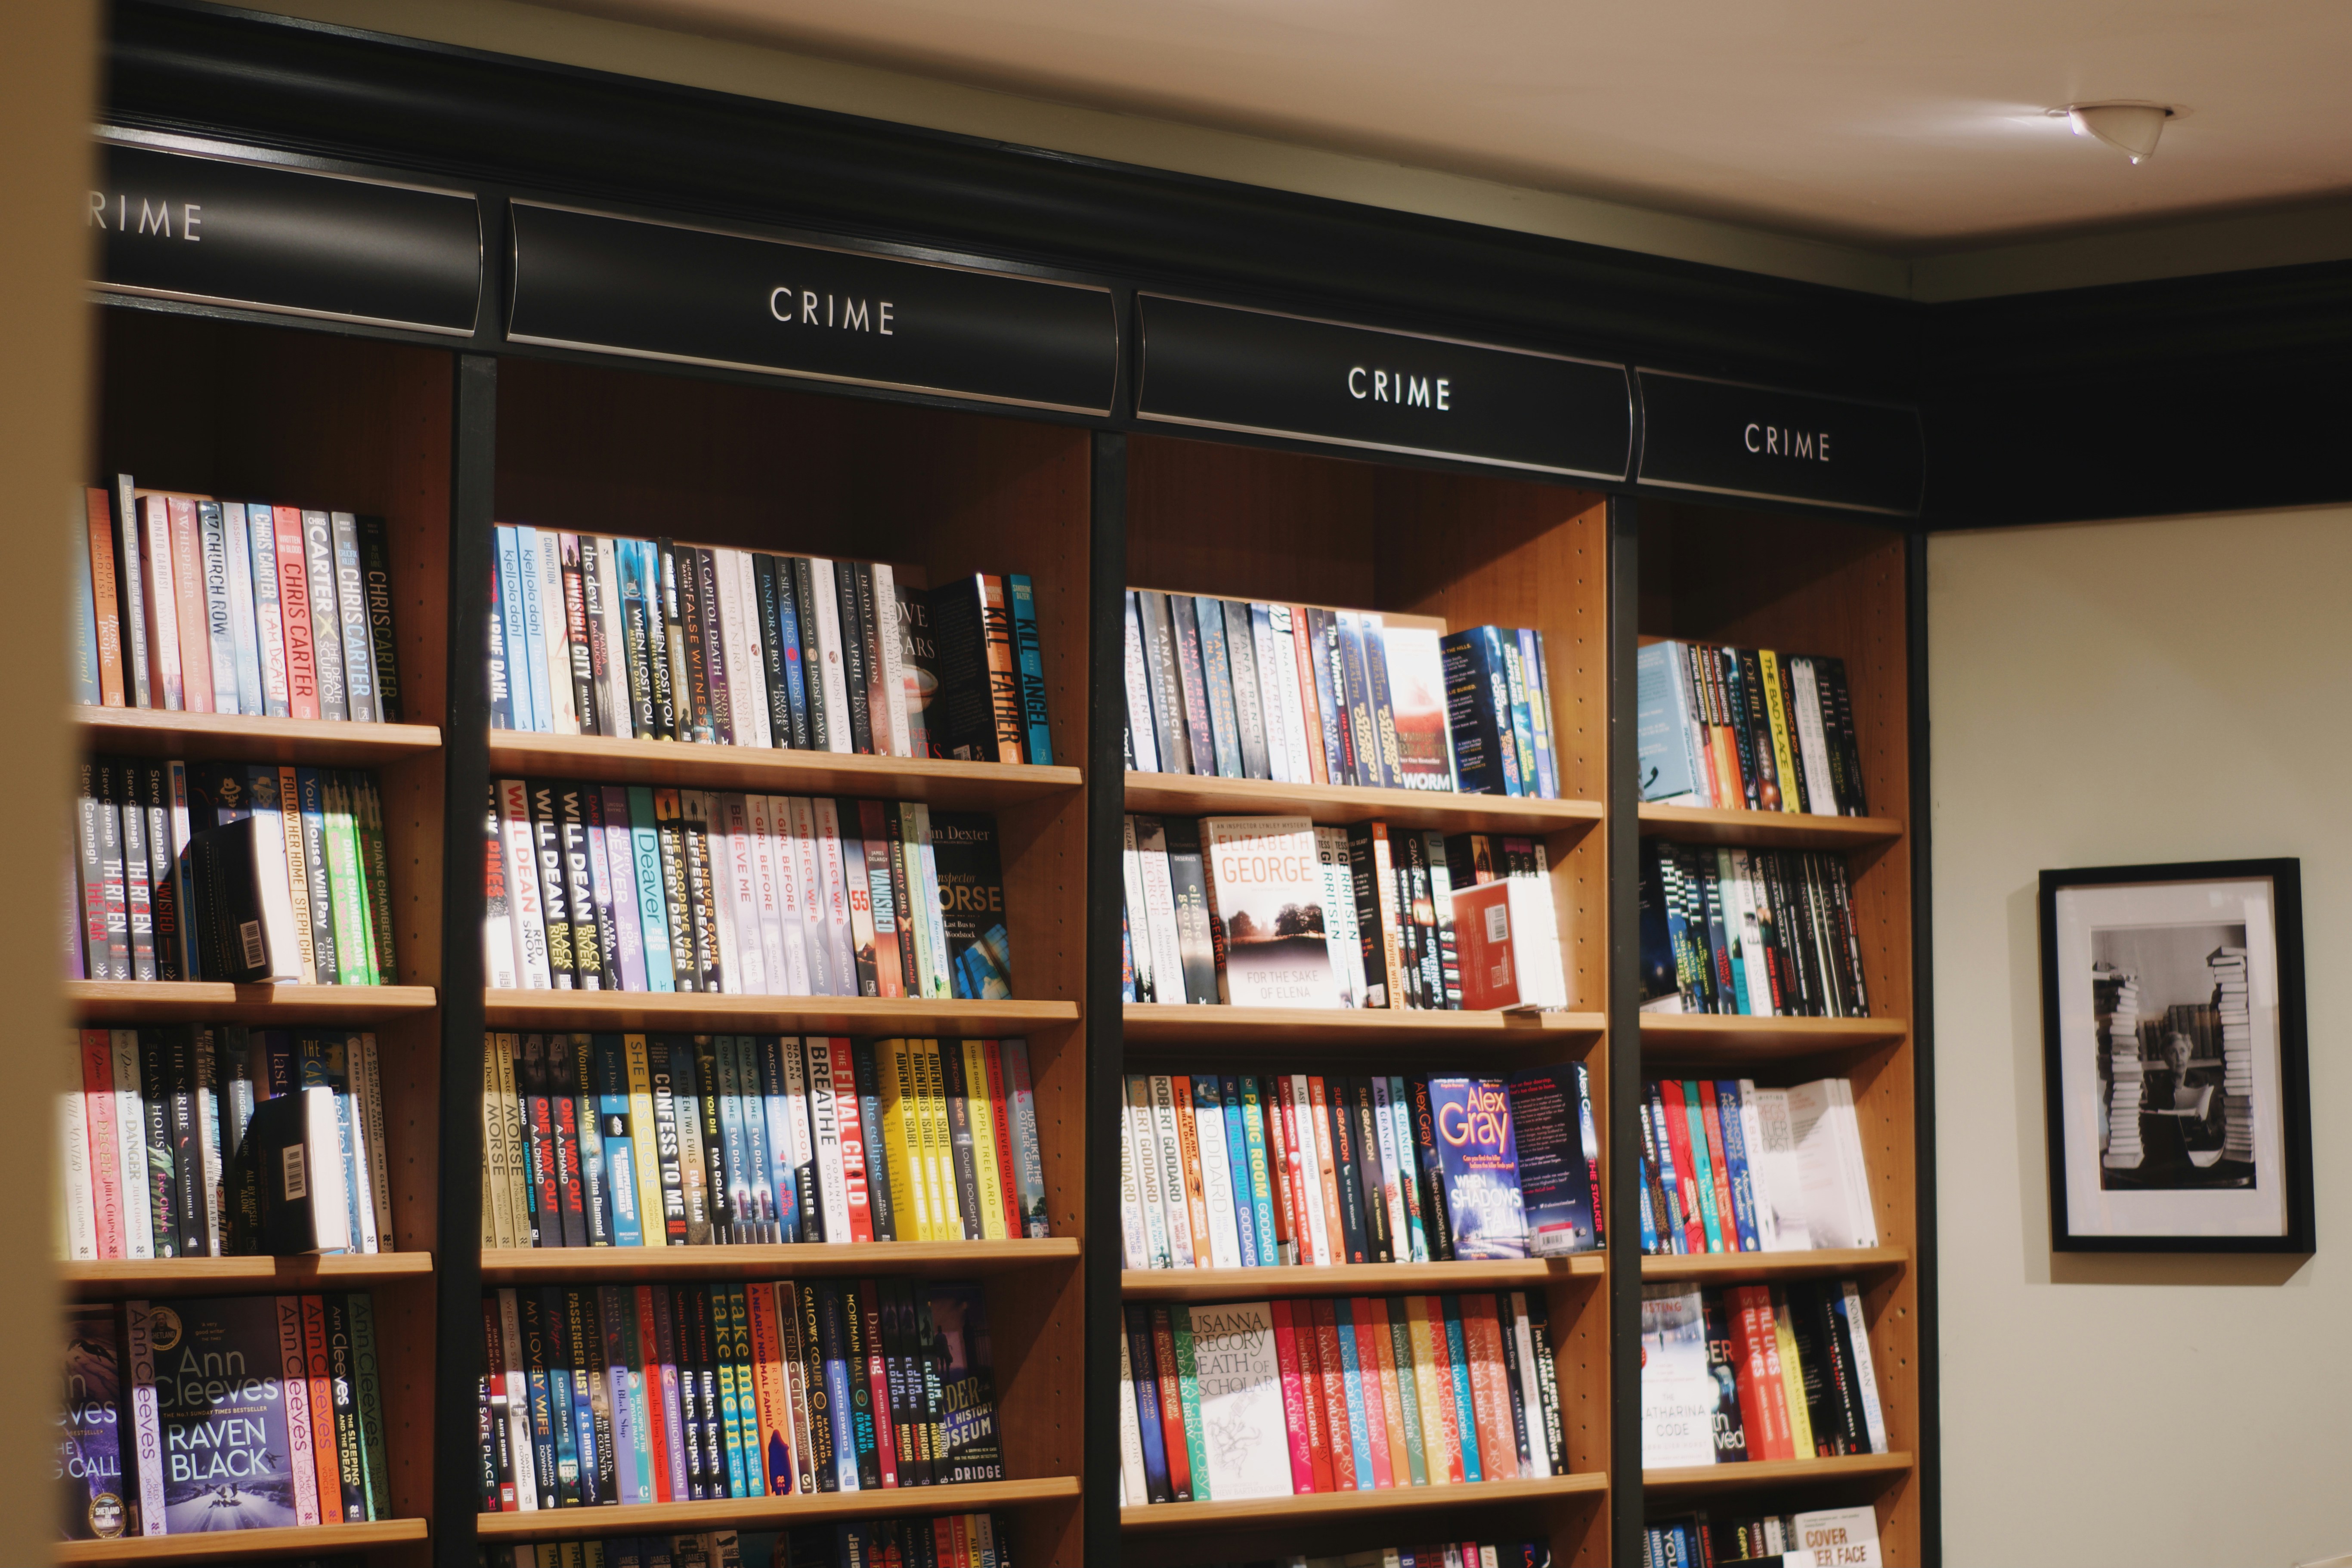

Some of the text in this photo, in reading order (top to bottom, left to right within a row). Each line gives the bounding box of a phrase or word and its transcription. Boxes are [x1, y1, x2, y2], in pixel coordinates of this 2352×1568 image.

[87, 189, 201, 241] RIME
[771, 286, 893, 336] CRIME
[1348, 367, 1450, 411] CRIME
[1745, 424, 1829, 461] CRIME
[205, 533, 229, 635] CHURCH ROW
[309, 526, 332, 612] CARTER
[544, 537, 555, 585] CONVICTION
[584, 546, 603, 620] the devil
[505, 550, 522, 637] kjell ola dahl
[703, 567, 722, 676] CAPITOL DEATH
[101, 621, 111, 667] people
[108, 615, 118, 653] those
[284, 563, 313, 697] CHRIS CARTER
[565, 573, 591, 679] INVISIBLE CITY
[861, 575, 878, 684] DEADLY ELECTION
[493, 657, 507, 702] DAHL
[634, 609, 653, 725] WHEN LOST YOU
[686, 594, 708, 726] FALSE WITNESS
[983, 607, 1021, 743] KILL FATHER
[1017, 618, 1048, 730] KILL ANGEL
[1160, 626, 1180, 739] TANA FRENCH
[1743, 656, 1761, 721] JOE HILL
[1491, 673, 1504, 728] Gardner
[1498, 684, 1508, 705] Lisa
[1768, 688, 1789, 769] BAD PLACE
[1403, 773, 1450, 790] WORM
[282, 776, 304, 885] FOLLOW HER HOME
[508, 786, 536, 912] WILL DEAN
[731, 804, 751, 902] BELIEVE ME
[948, 825, 990, 841] Dexter
[1218, 834, 1309, 851] ELIZABETH
[154, 808, 174, 932] Cavanagh TWISTED
[308, 817, 328, 929] House Will Pay
[487, 841, 504, 897] PINES
[638, 834, 660, 924] Deaver
[755, 817, 773, 911] GIRL BEFORE
[825, 827, 844, 925] PERFECT WIFE
[1222, 857, 1314, 883] GEORGE
[1318, 841, 1340, 939] TESS GERRITSEN
[851, 891, 869, 911] 55
[870, 869, 895, 934] VANISHED
[938, 886, 1001, 911] ORSE
[523, 921, 536, 965] SNOW
[533, 930, 543, 956] RED
[550, 925, 563, 966] RIVER
[559, 922, 573, 969] BLACK
[1247, 971, 1318, 984] FOR THE SAKE
[1260, 987, 1311, 999] OF ELENA
[1767, 947, 1780, 1008] ROGER HOBBS
[176, 1078, 189, 1130] SCRIBE
[630, 1042, 656, 1189] SHE LIES CLOSE
[655, 1074, 677, 1155] CONFESS
[811, 1046, 837, 1146] BREATHE
[835, 1070, 859, 1132] FINAL
[1467, 1087, 1506, 1112] Alex
[97, 1120, 112, 1178] DECEIT
[125, 1120, 141, 1180] DANGER
[505, 1104, 523, 1176] MORSE
[537, 1099, 557, 1212] ONE WAY OUT
[870, 1126, 882, 1181] eclipse
[977, 1105, 995, 1206] APPLE TREE YARD
[1439, 1102, 1507, 1153] Gray
[1721, 1093, 1737, 1160] HOROWITZ
[1728, 1093, 1745, 1160] ANTHONY
[585, 1110, 605, 1236] Water Katerina Diamond
[662, 1161, 681, 1184] TO
[1244, 1094, 1273, 1262] PANIC ROOM GODDARD
[1451, 1188, 1521, 1207] SHADOWS
[1455, 1175, 1486, 1188] WHEN
[666, 1190, 684, 1215] ME
[1485, 1208, 1518, 1230] FALL
[1591, 1184, 1603, 1232] STALKER
[569, 1293, 588, 1397] PASSENGER LIST
[867, 1313, 882, 1375] Darling
[1189, 1312, 1265, 1334] USANNA
[1192, 1327, 1268, 1356] REGORY
[1743, 1297, 1764, 1378] STILL LIVES
[132, 1310, 155, 1459] Ann Cleeves
[179, 1345, 246, 1376] Ann
[530, 1332, 549, 1435] LOVELY WIFE
[712, 1294, 741, 1449] take me in
[784, 1317, 803, 1414] STRING CITY
[1199, 1376, 1275, 1396] SCHOLAR
[1253, 1361, 1269, 1373] OF
[155, 1376, 279, 1408] Cleeves
[168, 1417, 267, 1450] RAVEN
[348, 1430, 359, 1486] SLEEPING
[480, 1405, 494, 1488] SAFE PLACE
[1656, 1423, 1689, 1436] CODE
[69, 1459, 121, 1477] CALL
[171, 1448, 270, 1481] BLACK
[1806, 1527, 1847, 1547] COVER
[1837, 1546, 1866, 1563] FACE
